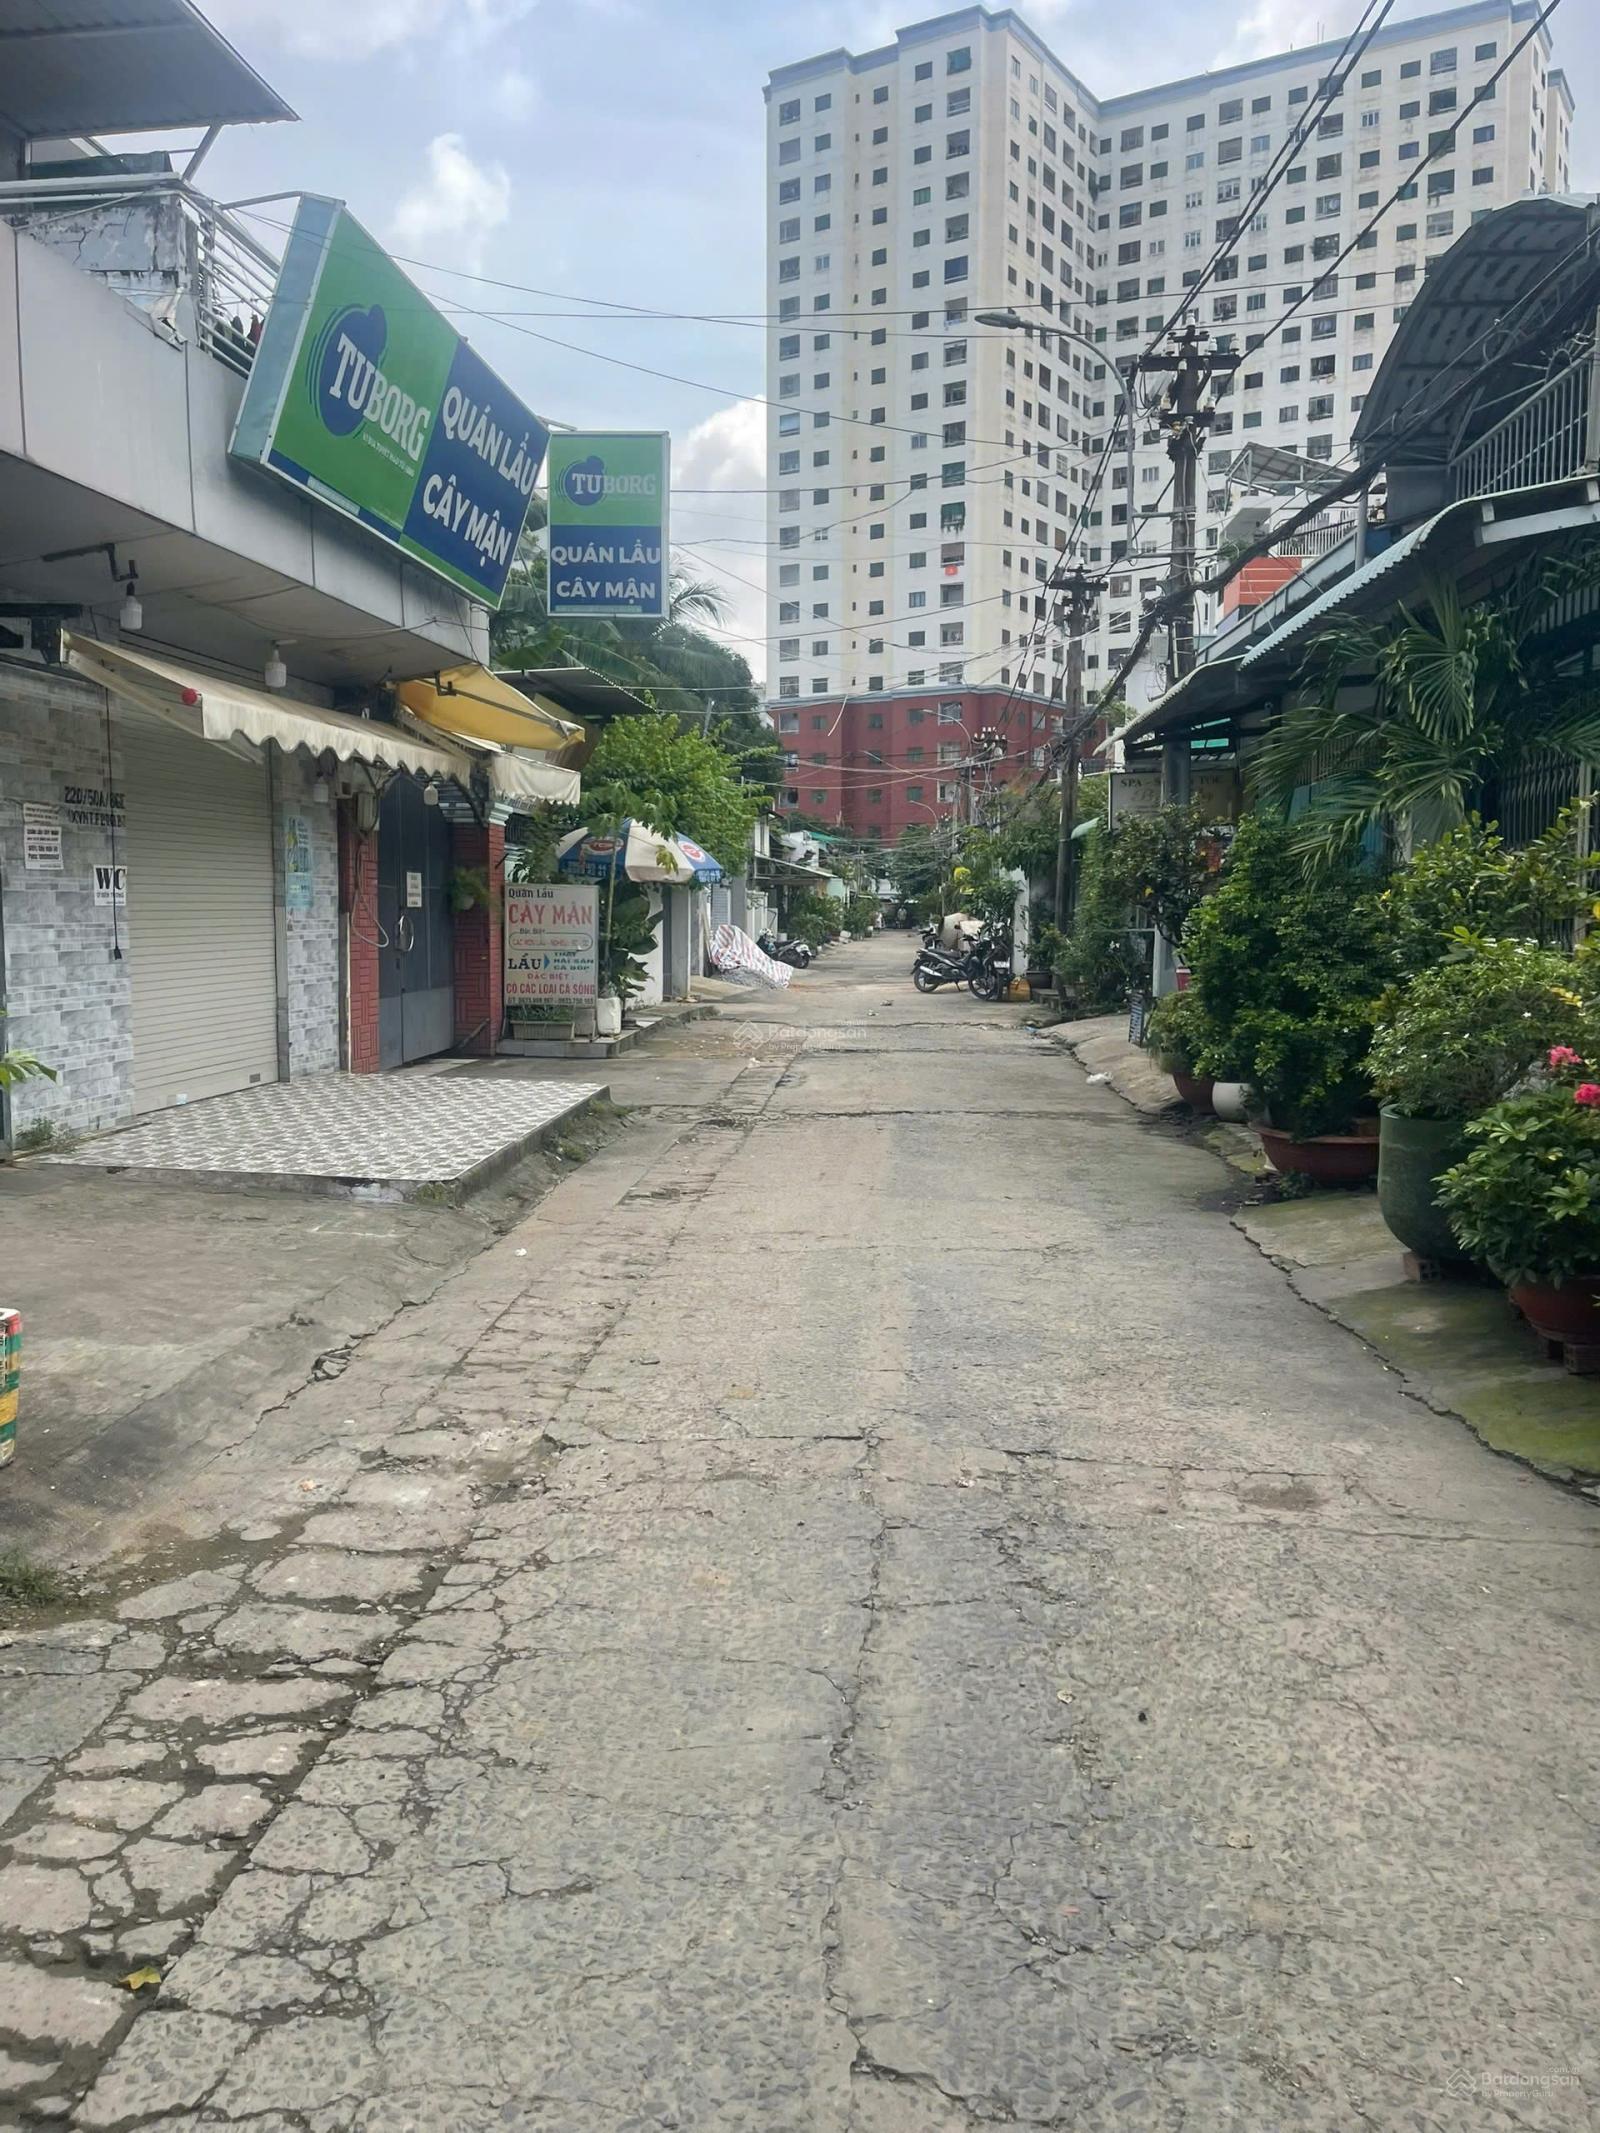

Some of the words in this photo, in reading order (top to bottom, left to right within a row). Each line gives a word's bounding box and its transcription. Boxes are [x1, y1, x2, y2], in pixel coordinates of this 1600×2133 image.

[329, 332, 431, 461] TUBORG
[442, 386, 504, 467] QUÁN
[498, 432, 537, 496] LẨU
[572, 473, 656, 495] TUBORG
[423, 473, 471, 533] CÂY
[464, 509, 512, 567] MẬN
[550, 542, 614, 566] QUÁN
[619, 539, 661, 565] LẨU
[556, 577, 600, 598] CÂY
[605, 578, 656, 604] MẬN
[96, 868, 126, 890] WC
[508, 900, 545, 925] CÂY
